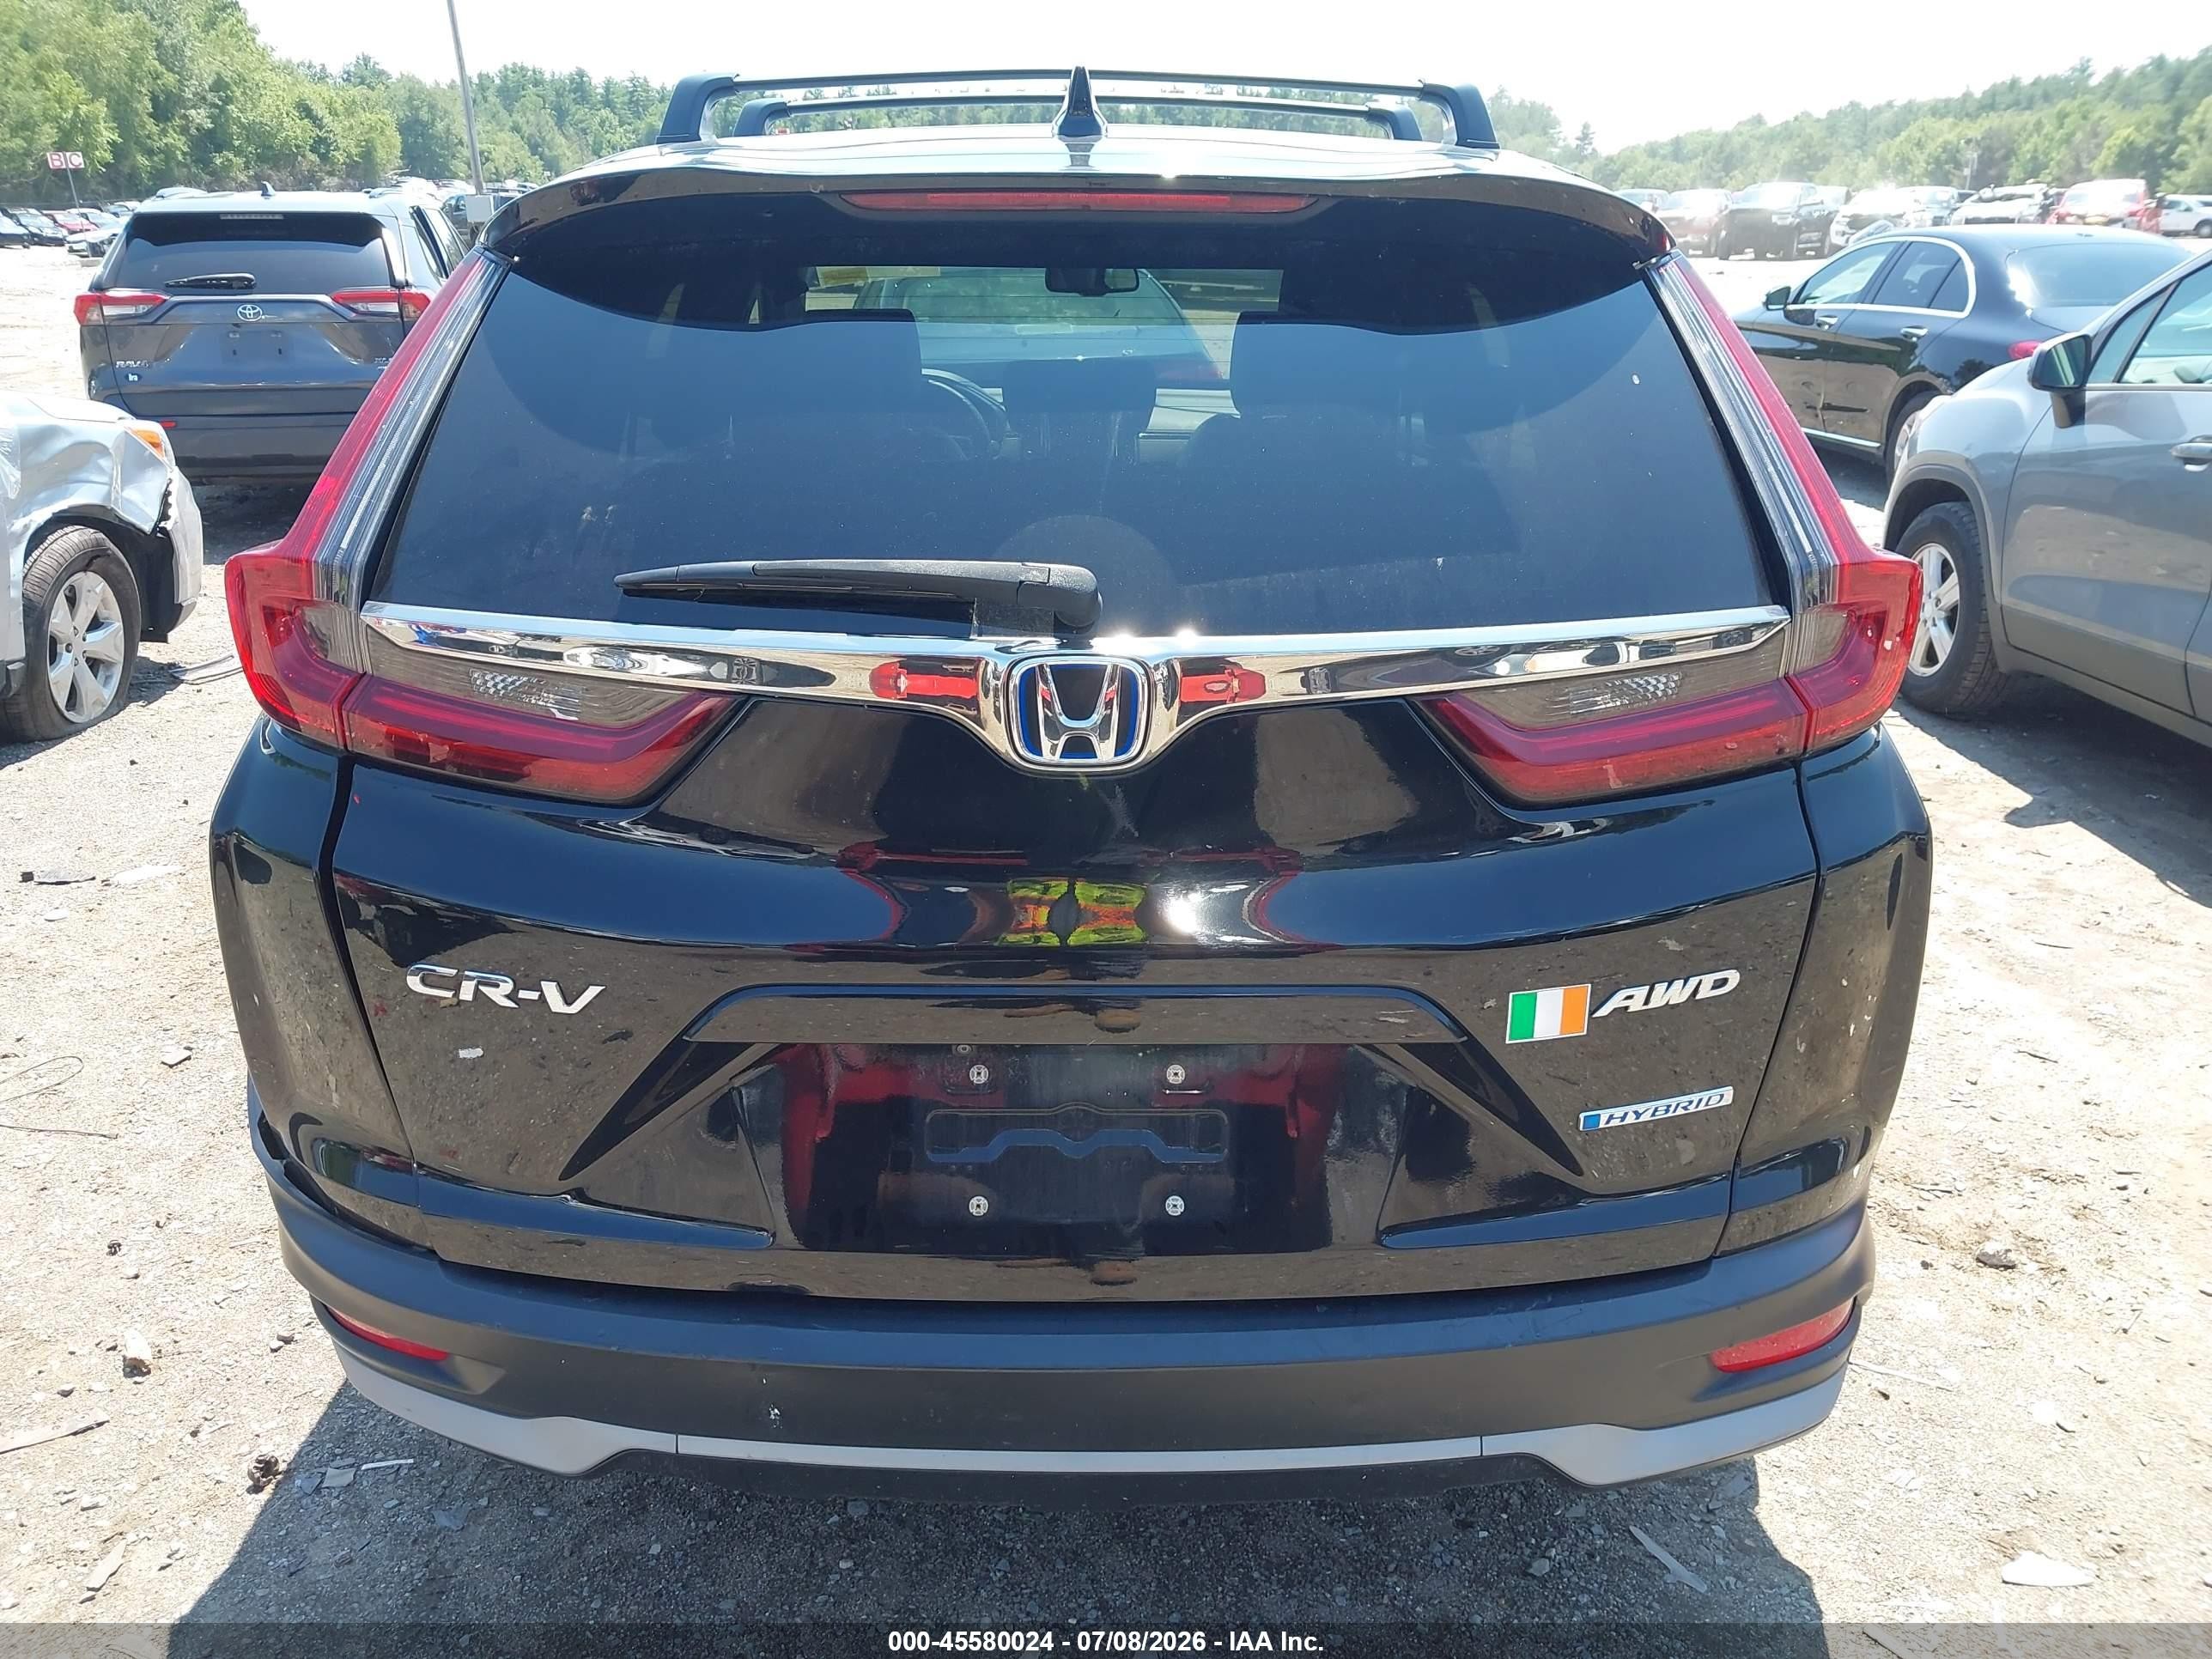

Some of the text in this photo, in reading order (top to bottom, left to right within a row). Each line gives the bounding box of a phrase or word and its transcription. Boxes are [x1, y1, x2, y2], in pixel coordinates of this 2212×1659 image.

[405, 963, 606, 1015] CR-V
[1591, 969, 1741, 1018] AWD
[1603, 1092, 1726, 1126] HYBRID
